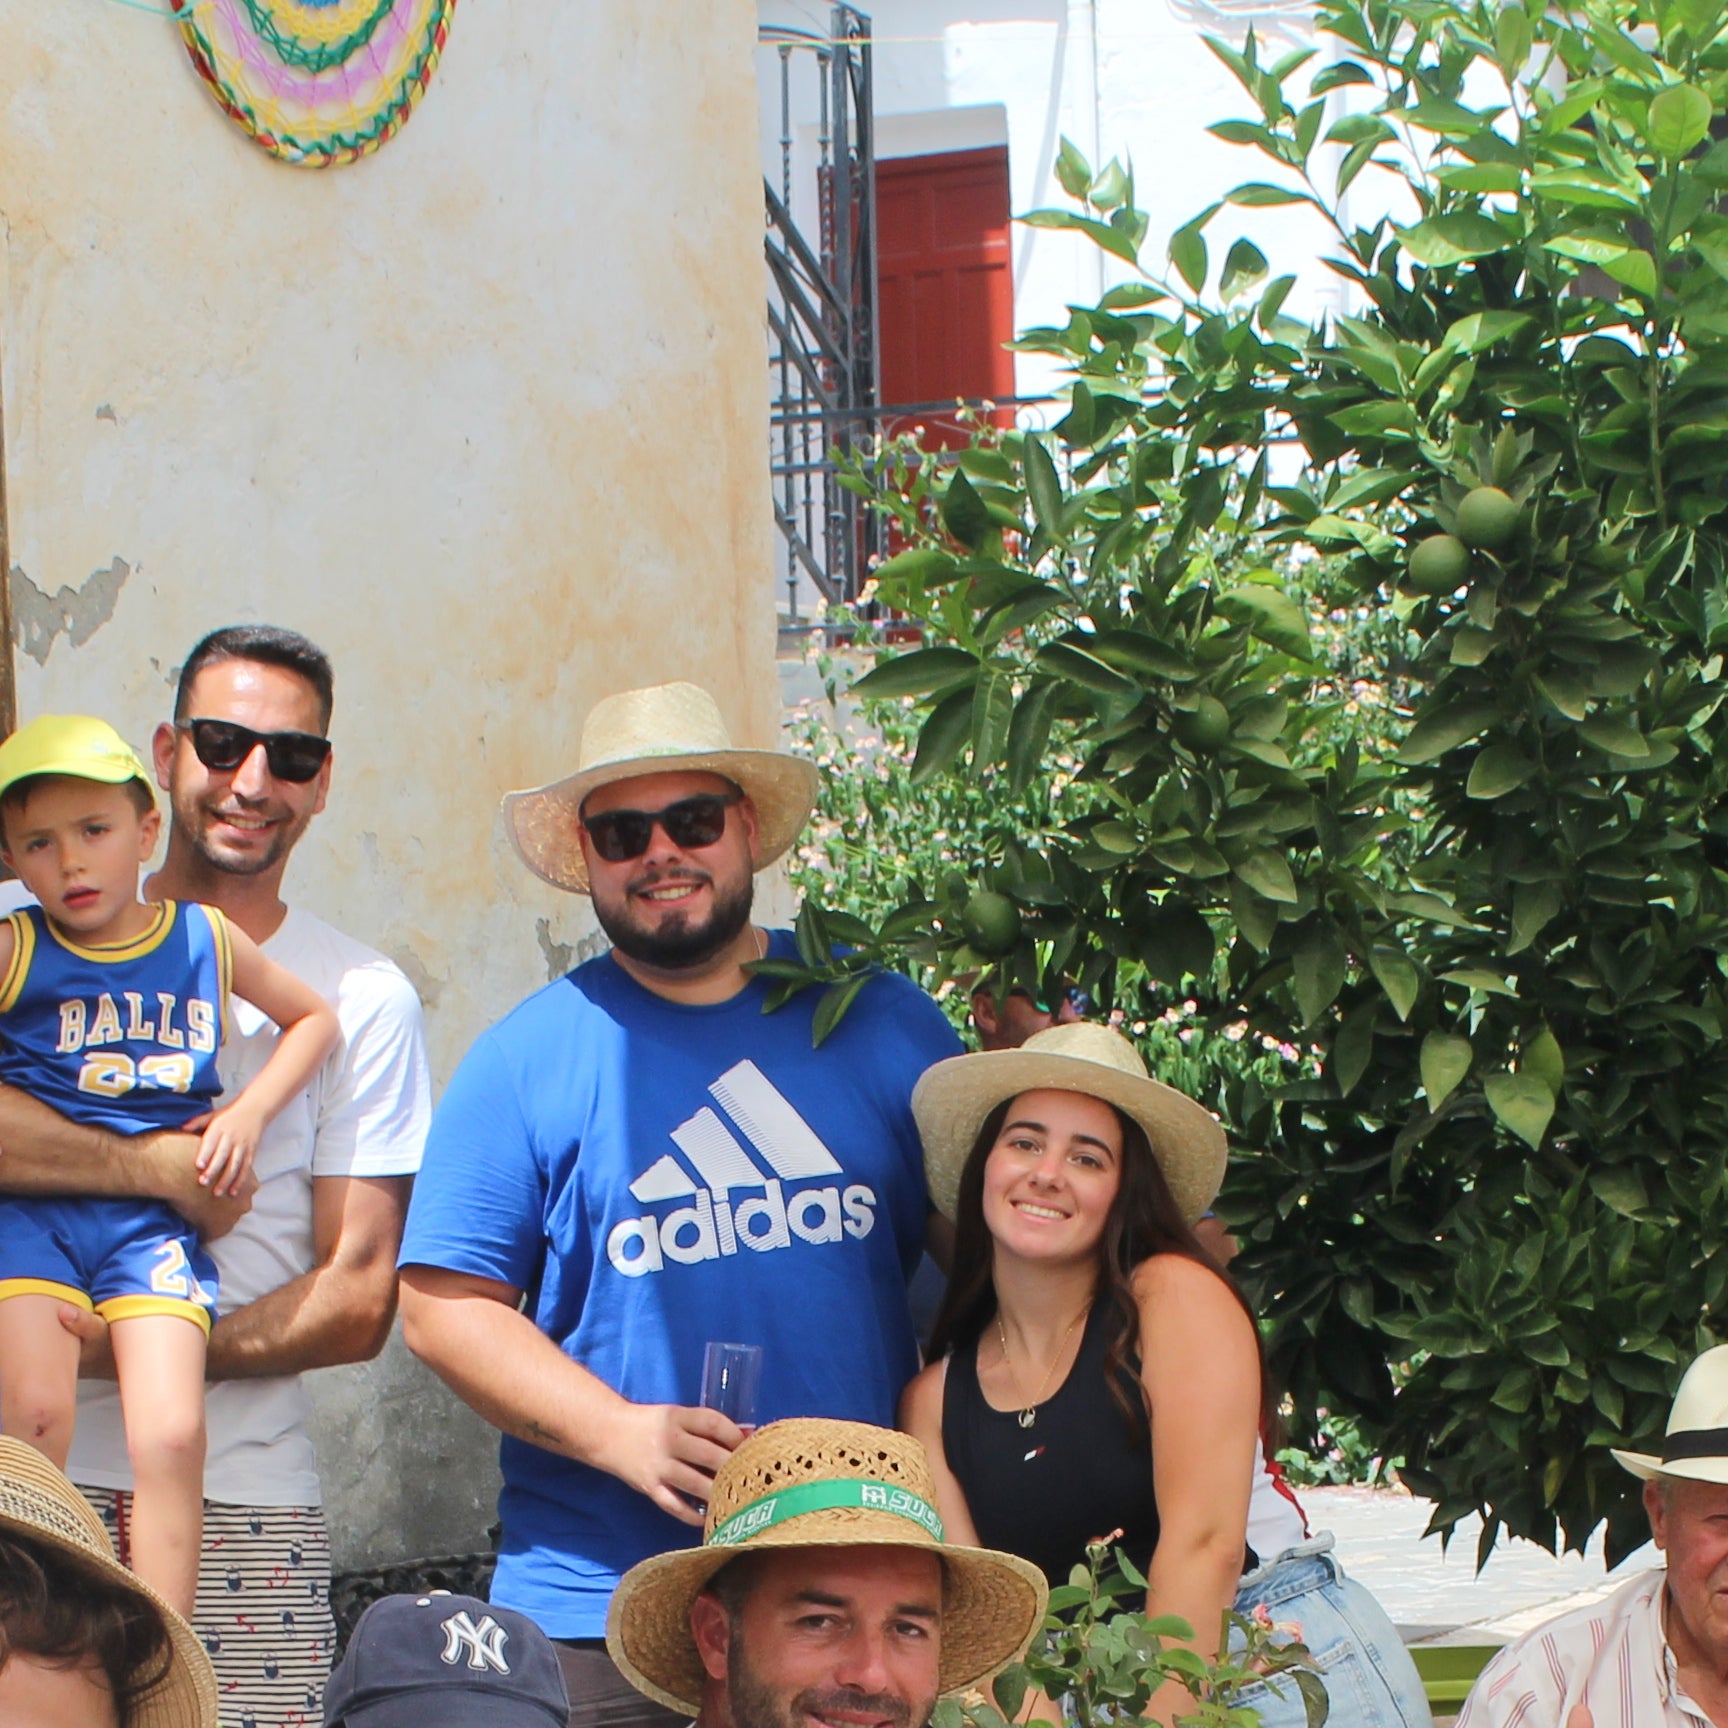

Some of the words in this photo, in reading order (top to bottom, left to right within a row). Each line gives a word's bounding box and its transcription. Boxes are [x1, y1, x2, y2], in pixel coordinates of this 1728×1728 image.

[56, 992, 216, 1053] BALLS
[77, 1052, 195, 1098] 23
[607, 1178, 877, 1278] adidas
